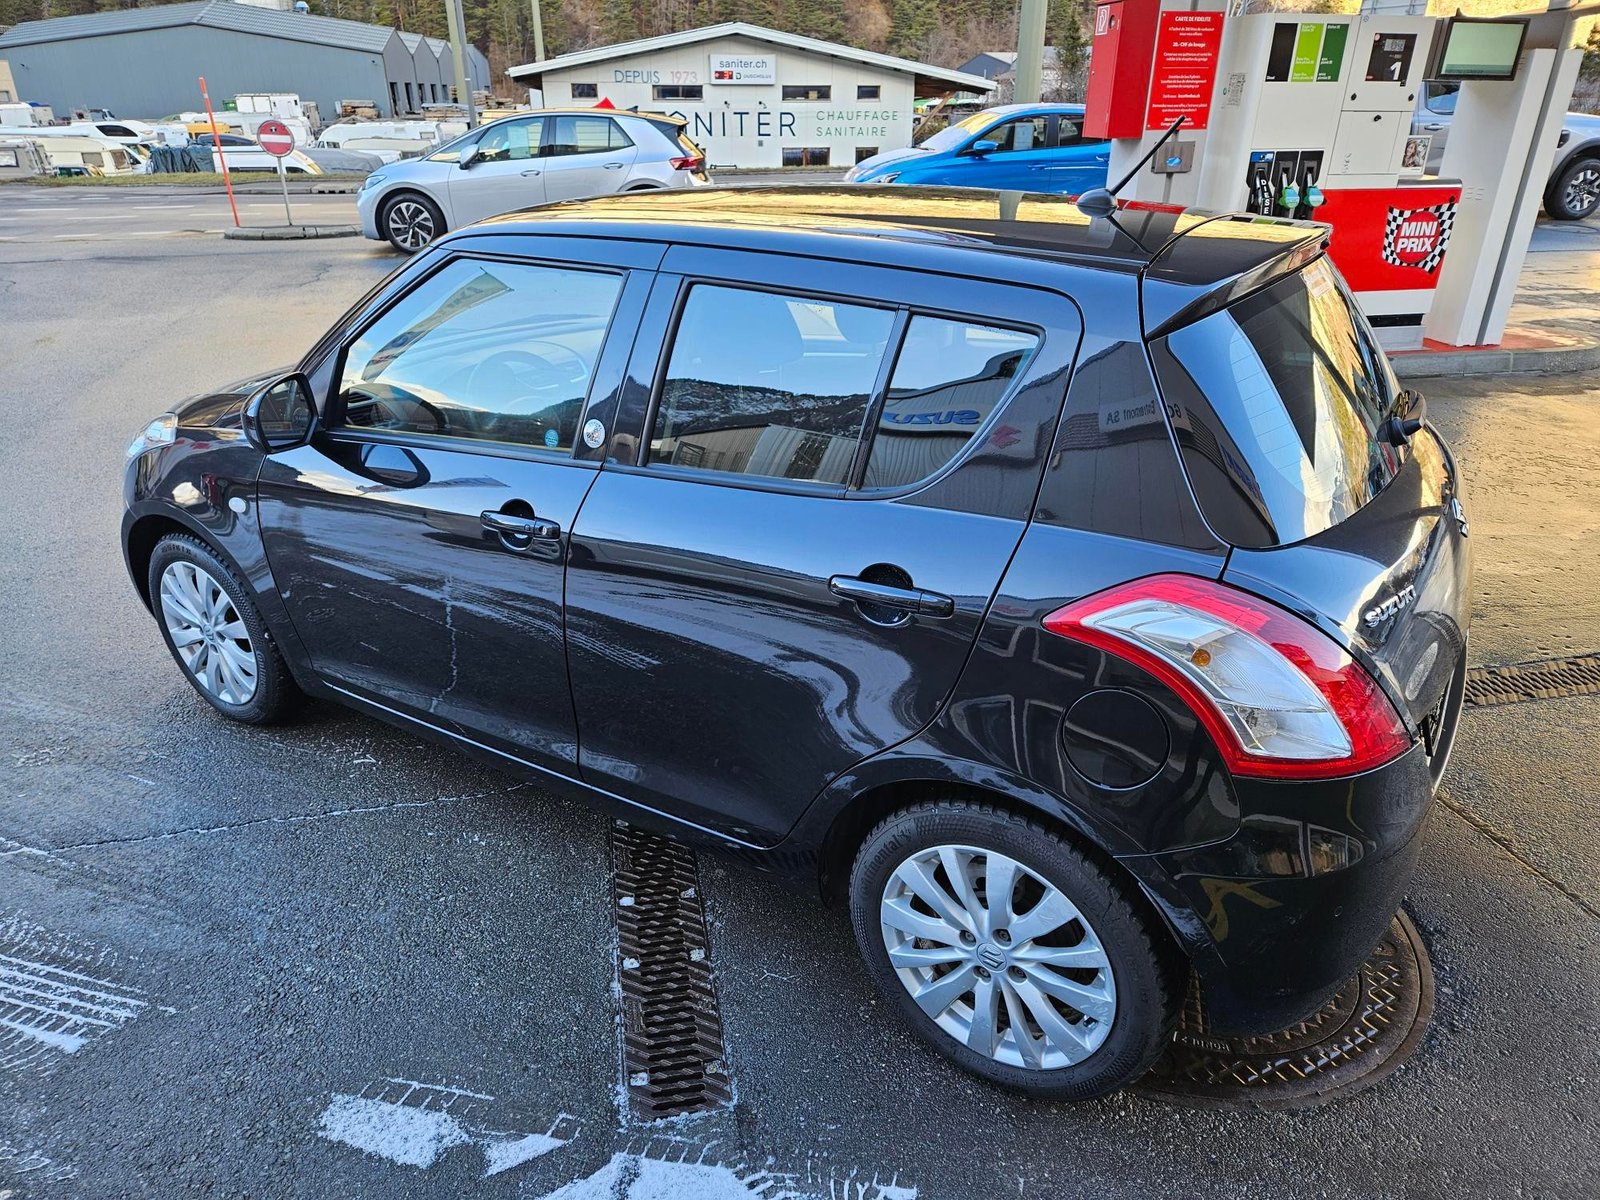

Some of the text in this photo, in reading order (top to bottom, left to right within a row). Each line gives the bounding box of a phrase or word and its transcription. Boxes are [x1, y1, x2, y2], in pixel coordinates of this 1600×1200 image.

[719, 59, 767, 69] saniter.ch
[1390, 61, 1402, 81] 1
[614, 69, 698, 84] DEPUIS 1973
[816, 110, 899, 121] CHAUFFAGE
[668, 110, 796, 138] NITER
[816, 126, 888, 137] SANITAIRE
[1260, 179, 1271, 215] DIESE
[1400, 221, 1438, 237] MINI
[1396, 237, 1435, 253] PRIX
[1364, 584, 1417, 628] SUZUKI
